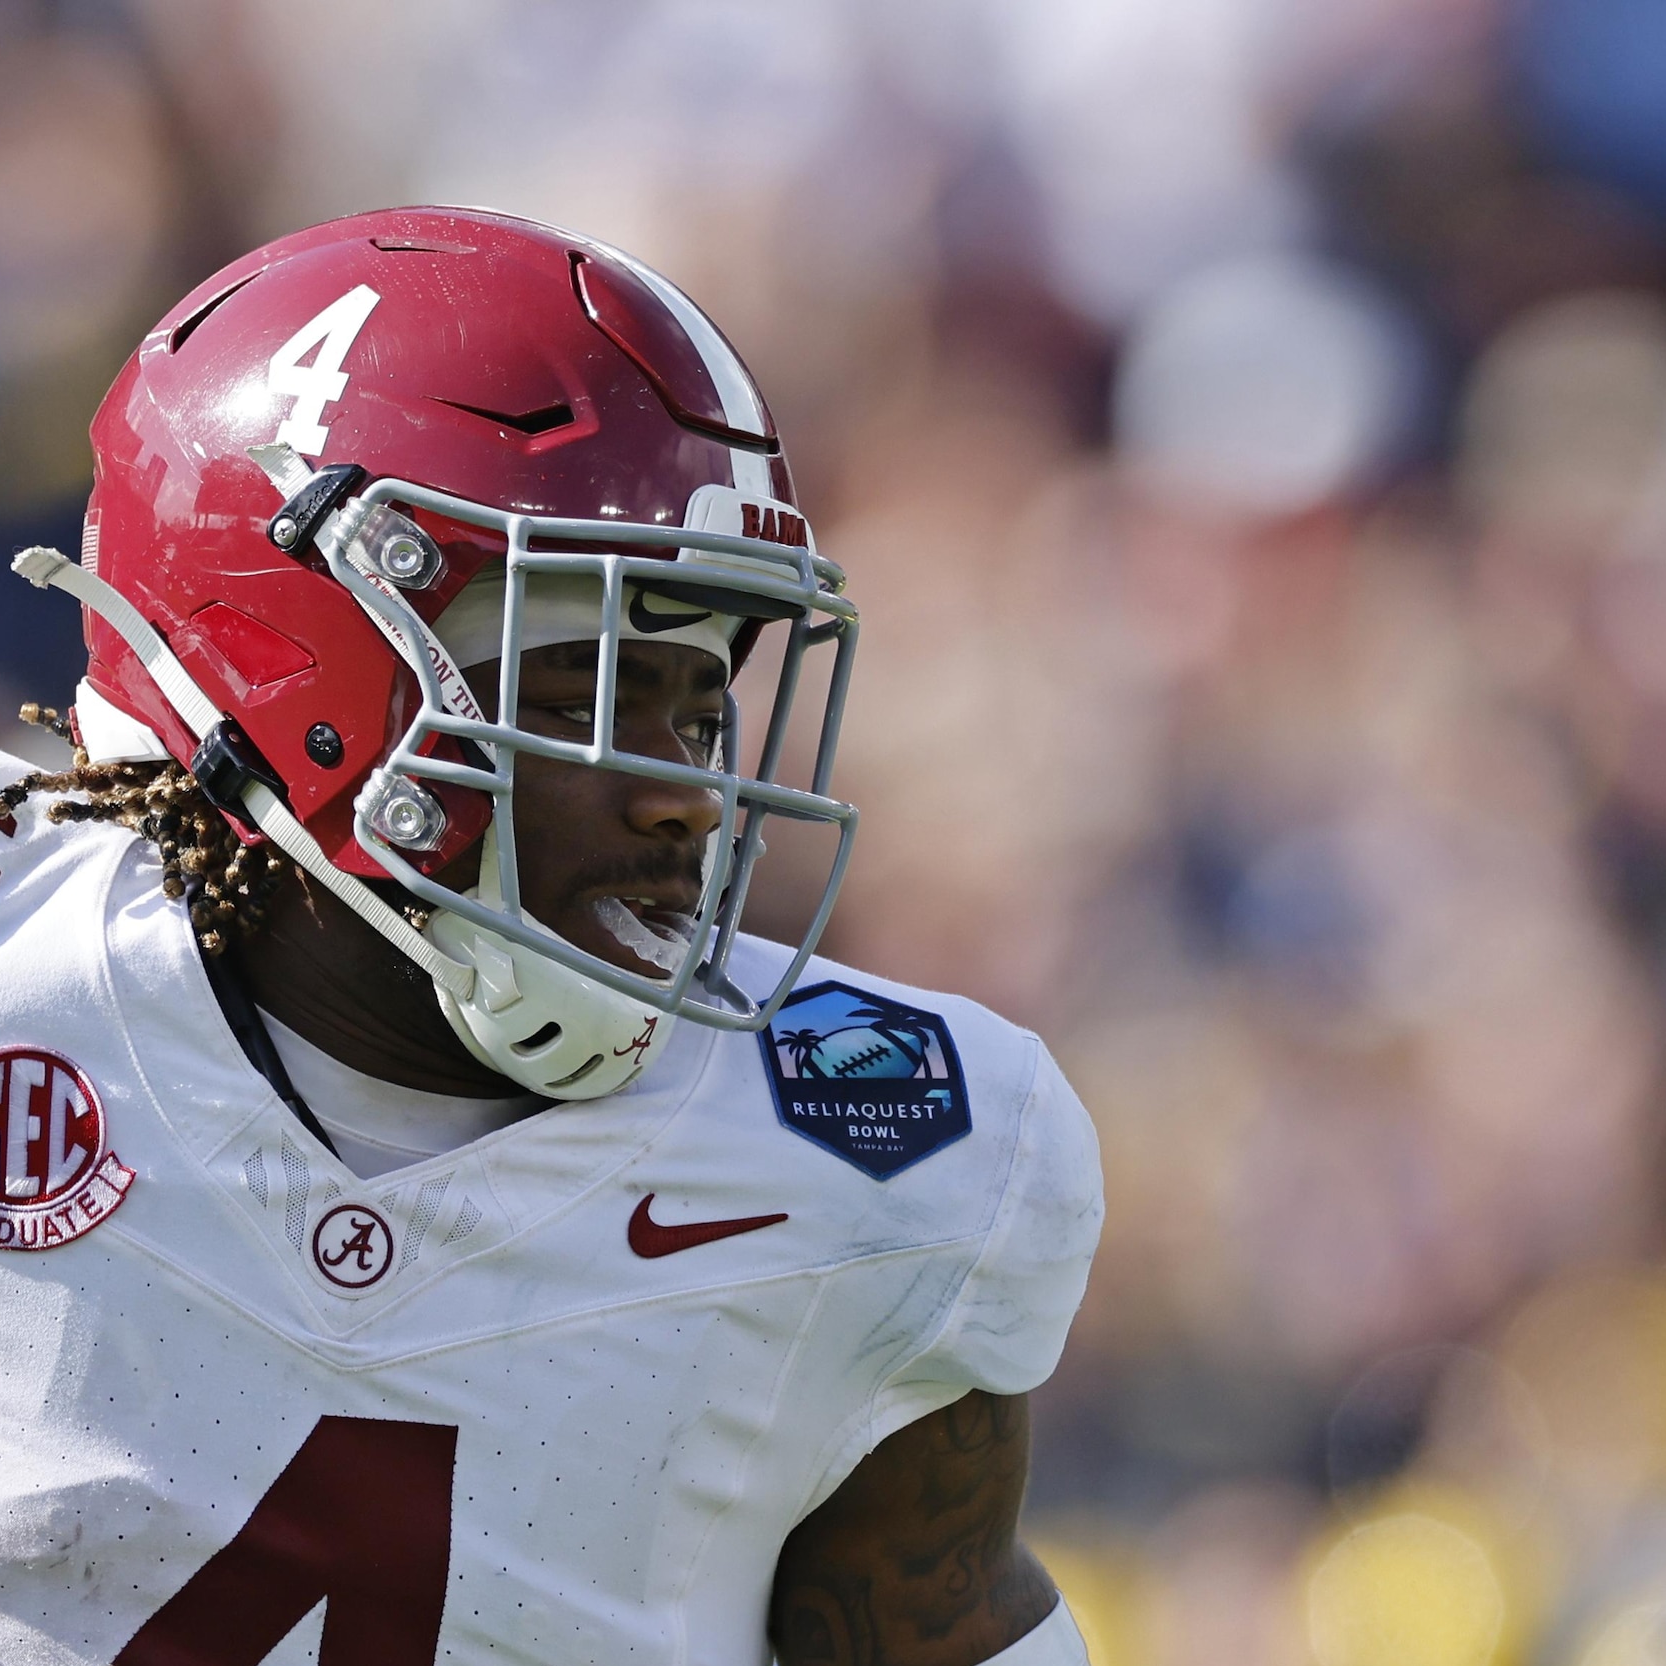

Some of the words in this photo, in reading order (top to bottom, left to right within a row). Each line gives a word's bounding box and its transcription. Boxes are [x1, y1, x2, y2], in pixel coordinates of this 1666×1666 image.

[267, 283, 382, 457] 4
[792, 1101, 935, 1120] RELIAQUEST
[848, 1124, 900, 1139] BOWL
[851, 1142, 883, 1151] TAMPA
[886, 1143, 904, 1152] BAY
